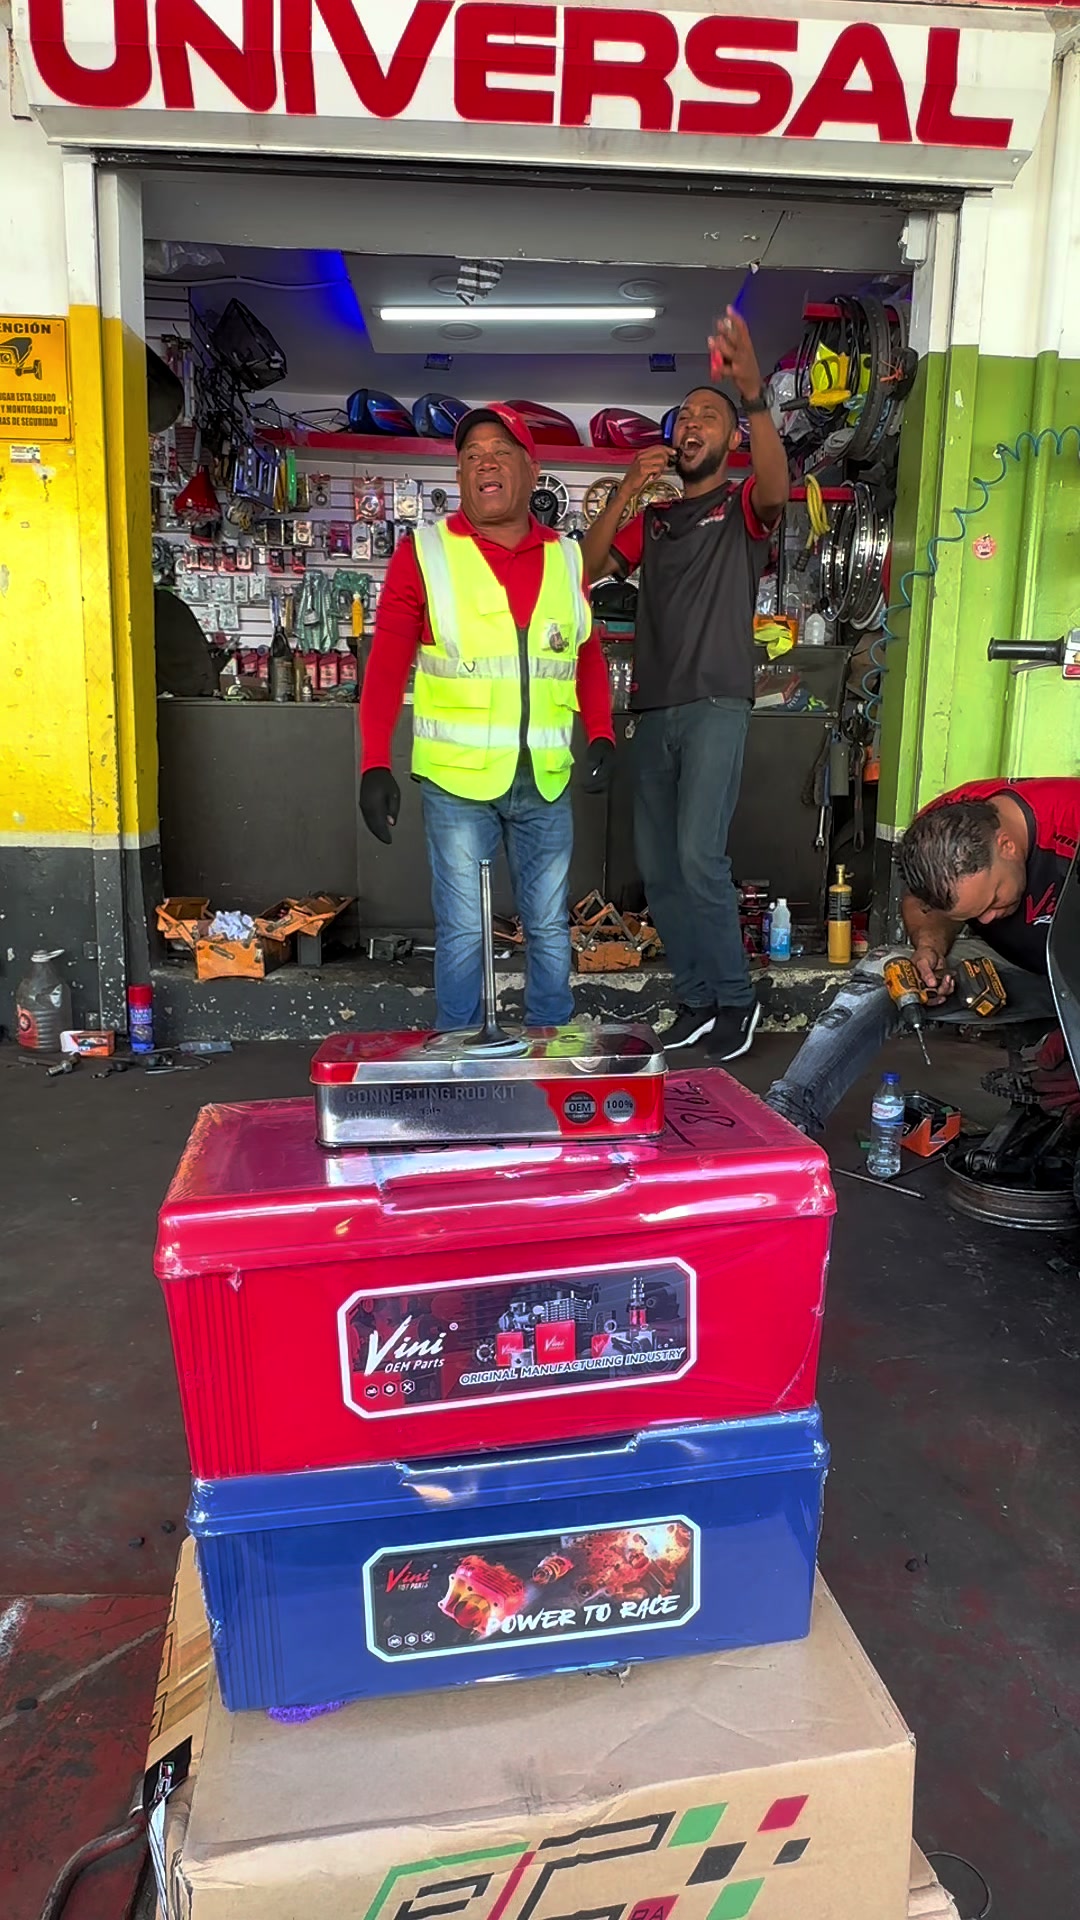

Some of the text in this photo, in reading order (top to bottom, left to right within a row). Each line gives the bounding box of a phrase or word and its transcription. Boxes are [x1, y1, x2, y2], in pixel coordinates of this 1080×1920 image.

[29, 0, 1014, 149] UNIVERSAL
[0, 322, 51, 335] NCIÓN
[16, 392, 32, 402] ESTA
[6, 404, 53, 415] MONITOREADO
[12, 417, 20, 426] DE
[21, 417, 58, 427] SEGURIDAD
[1026, 882, 1056, 924] Vi
[346, 1084, 517, 1104] CONNECTING ROD KIT
[568, 1103, 592, 1112] OEM
[607, 1099, 634, 1109] 100%
[364, 1314, 447, 1377] Vini
[384, 1358, 446, 1374] OEM Parts
[460, 1346, 686, 1386] ORIGINAL MANUFACTURING INDUSTRY
[385, 1559, 432, 1593] Vini
[486, 1594, 681, 1635] POWER TO RACE
